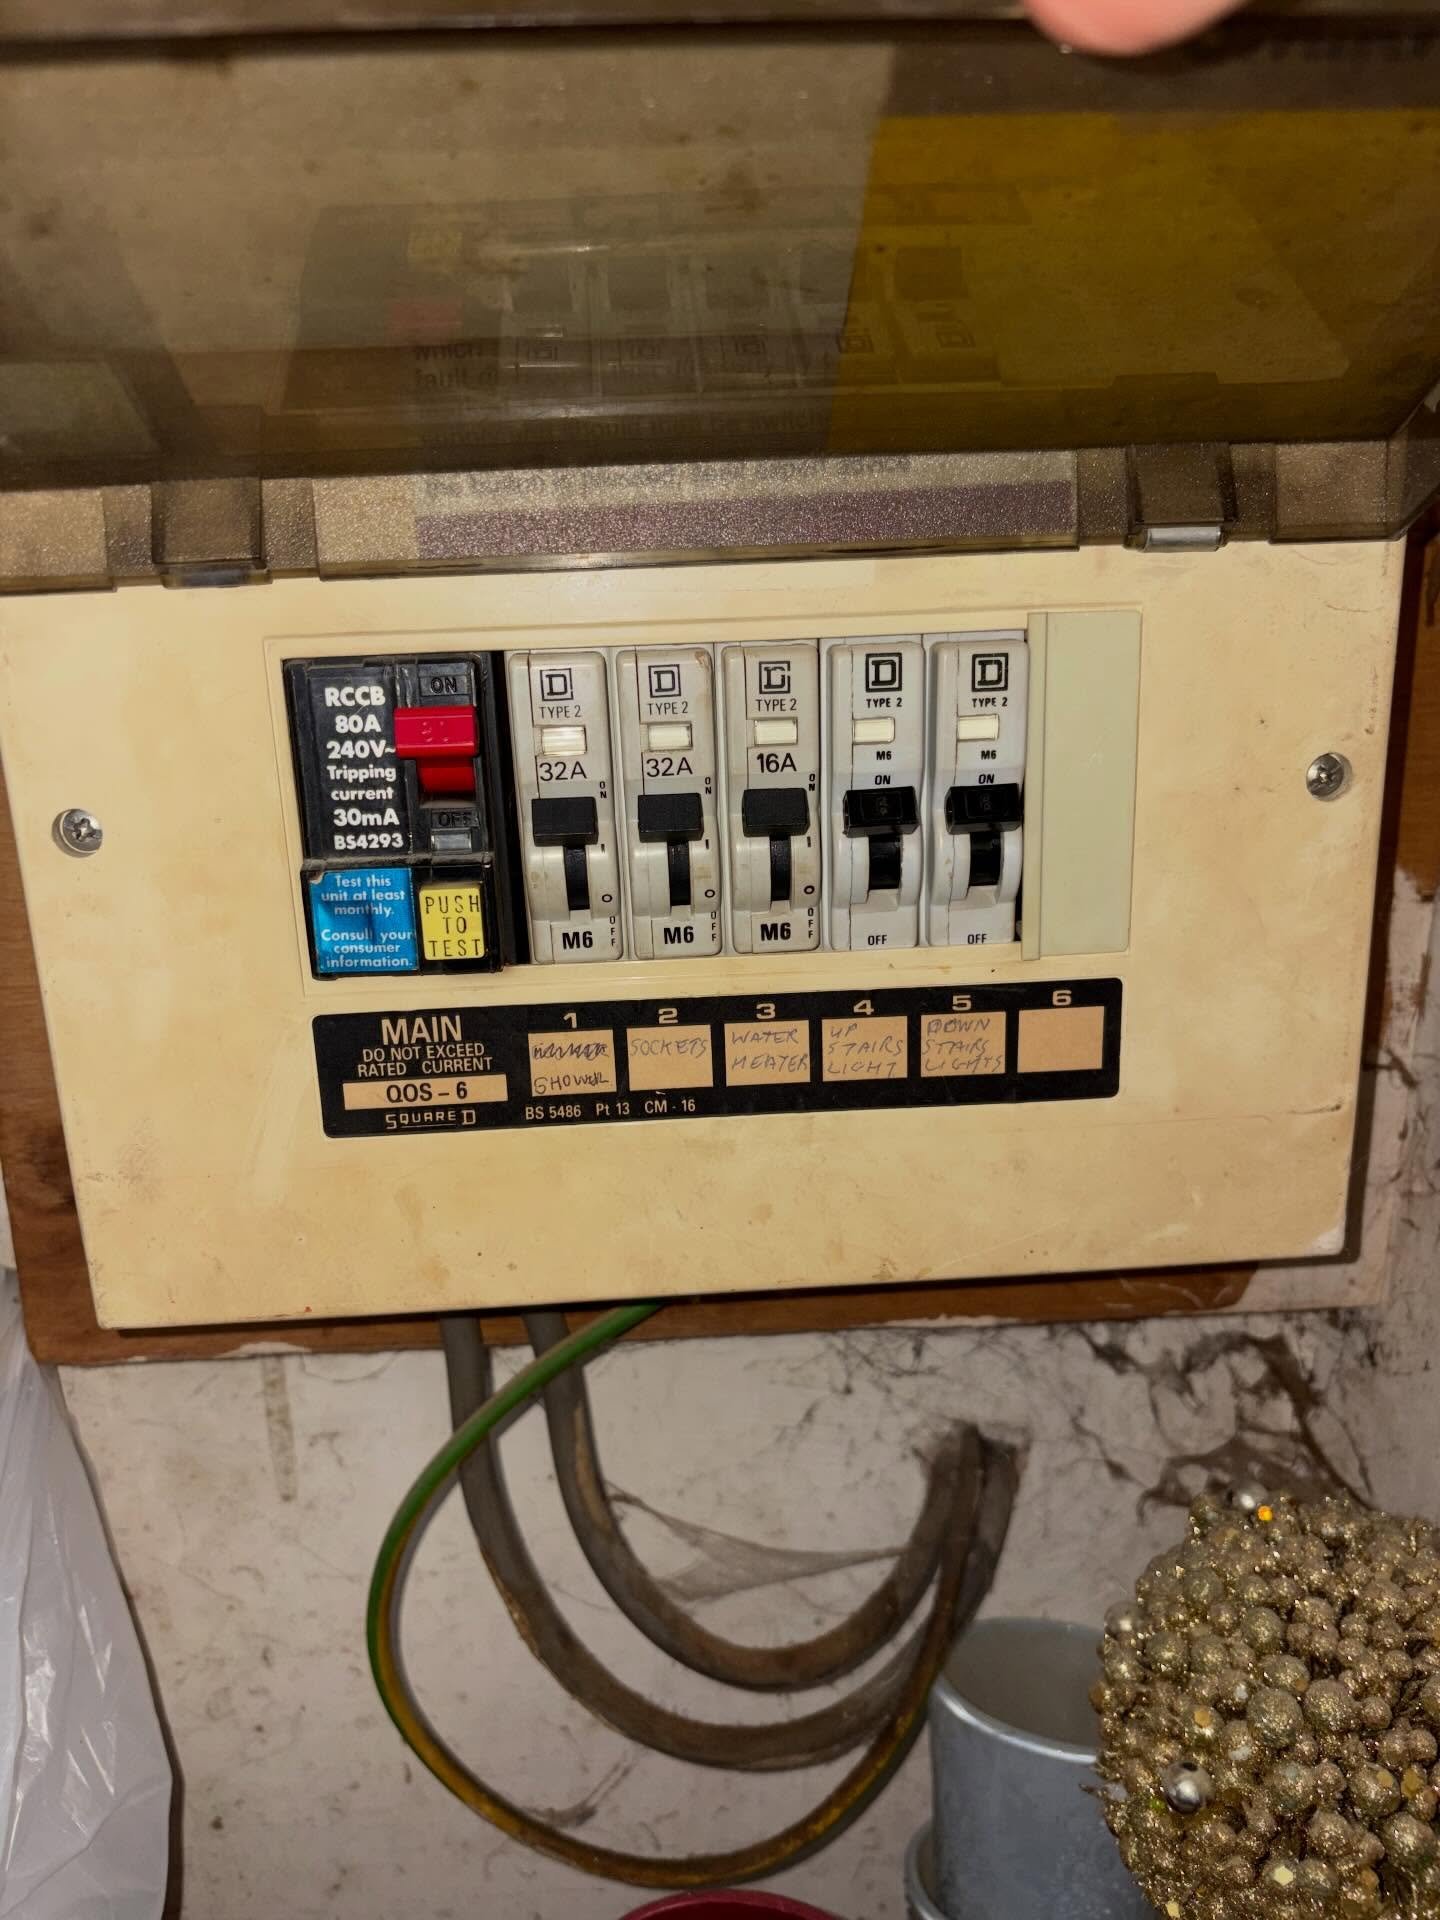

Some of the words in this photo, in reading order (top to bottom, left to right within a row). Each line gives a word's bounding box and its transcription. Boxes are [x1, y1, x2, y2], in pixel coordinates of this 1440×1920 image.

[430, 677, 457, 694] ON
[324, 685, 386, 708] RCCB
[755, 699, 787, 712] TYPE
[789, 698, 798, 711] 2
[866, 698, 891, 709] TYPE
[896, 697, 903, 708] 2
[972, 698, 997, 708] TYPE
[1001, 697, 1008, 707] 2
[539, 706, 572, 718] TYPE
[574, 705, 582, 717] 2
[647, 703, 679, 715] TYPE
[681, 701, 689, 714] 2
[335, 714, 381, 734] 80A
[756, 752, 797, 773] 16A
[876, 750, 892, 761] M6
[981, 750, 996, 760] M6
[327, 764, 396, 783] Tripping
[539, 761, 587, 781] 32A
[646, 756, 693, 777] 32A
[874, 774, 891, 786] ON
[978, 773, 995, 785] ON
[331, 785, 394, 801] current
[333, 808, 399, 828] 30mA
[439, 811, 471, 827] OFF
[334, 834, 403, 850] BS4293
[336, 875, 361, 888] Test
[366, 874, 391, 887] this
[321, 889, 348, 901] unit
[353, 889, 367, 900] at
[372, 888, 405, 900] least
[334, 904, 394, 917] monthly.
[425, 895, 480, 914] PUSH
[442, 916, 467, 934] TO
[760, 922, 791, 941] M6
[380, 931, 412, 943] your
[562, 931, 594, 950] M6
[663, 926, 694, 944] M6
[867, 935, 888, 946] OFF
[967, 934, 987, 945] OFF
[333, 943, 400, 953] consumer
[428, 939, 481, 957] TEST
[326, 955, 413, 968] information.
[952, 995, 972, 1012] 5
[1052, 990, 1072, 1006] 6
[658, 1007, 679, 1025] 2
[756, 1003, 776, 1019] 3
[853, 1000, 875, 1016] 4
[564, 1012, 578, 1029] 1
[927, 1019, 990, 1034] DOWN
[381, 1015, 463, 1046] MAIN
[731, 1029, 799, 1044] WATER
[830, 1024, 858, 1038] UP
[362, 1048, 386, 1063] DO
[390, 1046, 422, 1061] NOT
[427, 1043, 485, 1060] EXCEED
[630, 1037, 709, 1059] SOCKETS
[828, 1039, 903, 1056] STAIRS
[923, 1038, 990, 1055] STAIRS
[357, 1062, 407, 1079] RATED
[421, 1057, 492, 1074] CURRENT
[731, 1053, 808, 1071] HEATER
[828, 1060, 896, 1077] LIGHT
[925, 1056, 1001, 1073] LIGHTS
[457, 1081, 468, 1099] 6
[525, 1106, 544, 1120] BS
[550, 1104, 581, 1119] 5486
[596, 1103, 610, 1116] Pt
[616, 1103, 630, 1115] 13
[645, 1101, 667, 1114] CM
[682, 1099, 696, 1112] 16
[385, 1111, 456, 1130] SQUARE
[462, 1110, 476, 1125] D
